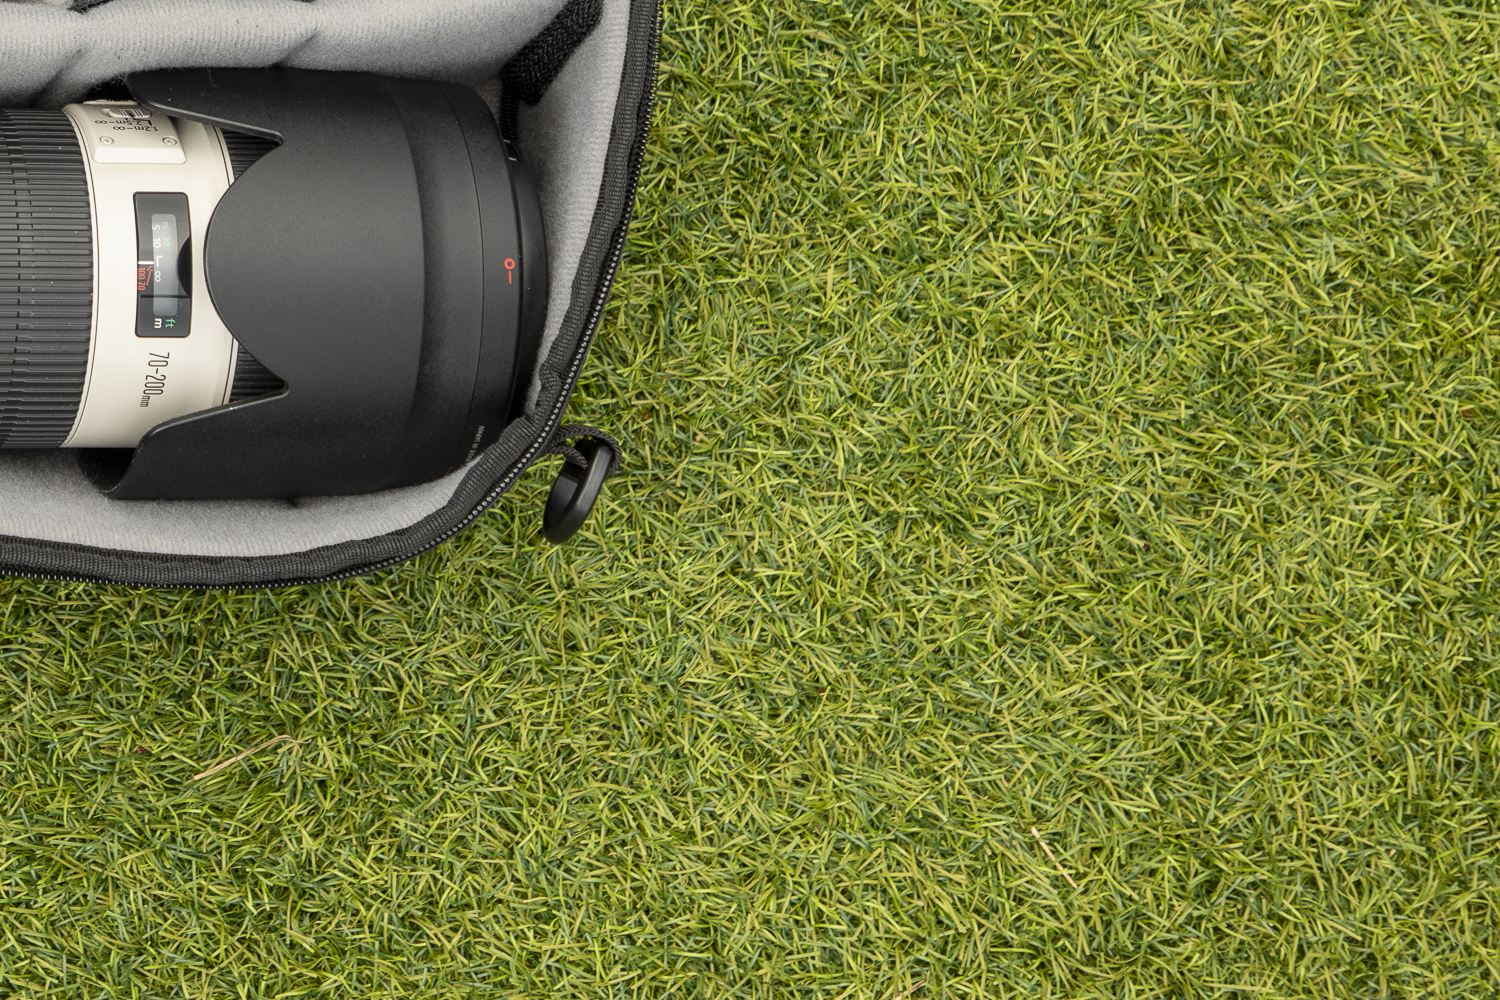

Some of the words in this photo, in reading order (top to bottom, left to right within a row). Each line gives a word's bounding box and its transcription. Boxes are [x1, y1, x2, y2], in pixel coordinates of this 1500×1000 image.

[153, 238, 161, 248] 10
[163, 237, 170, 246] 30
[154, 318, 162, 329] m
[166, 318, 175, 328] ft
[140, 352, 170, 407] 70-200mm
